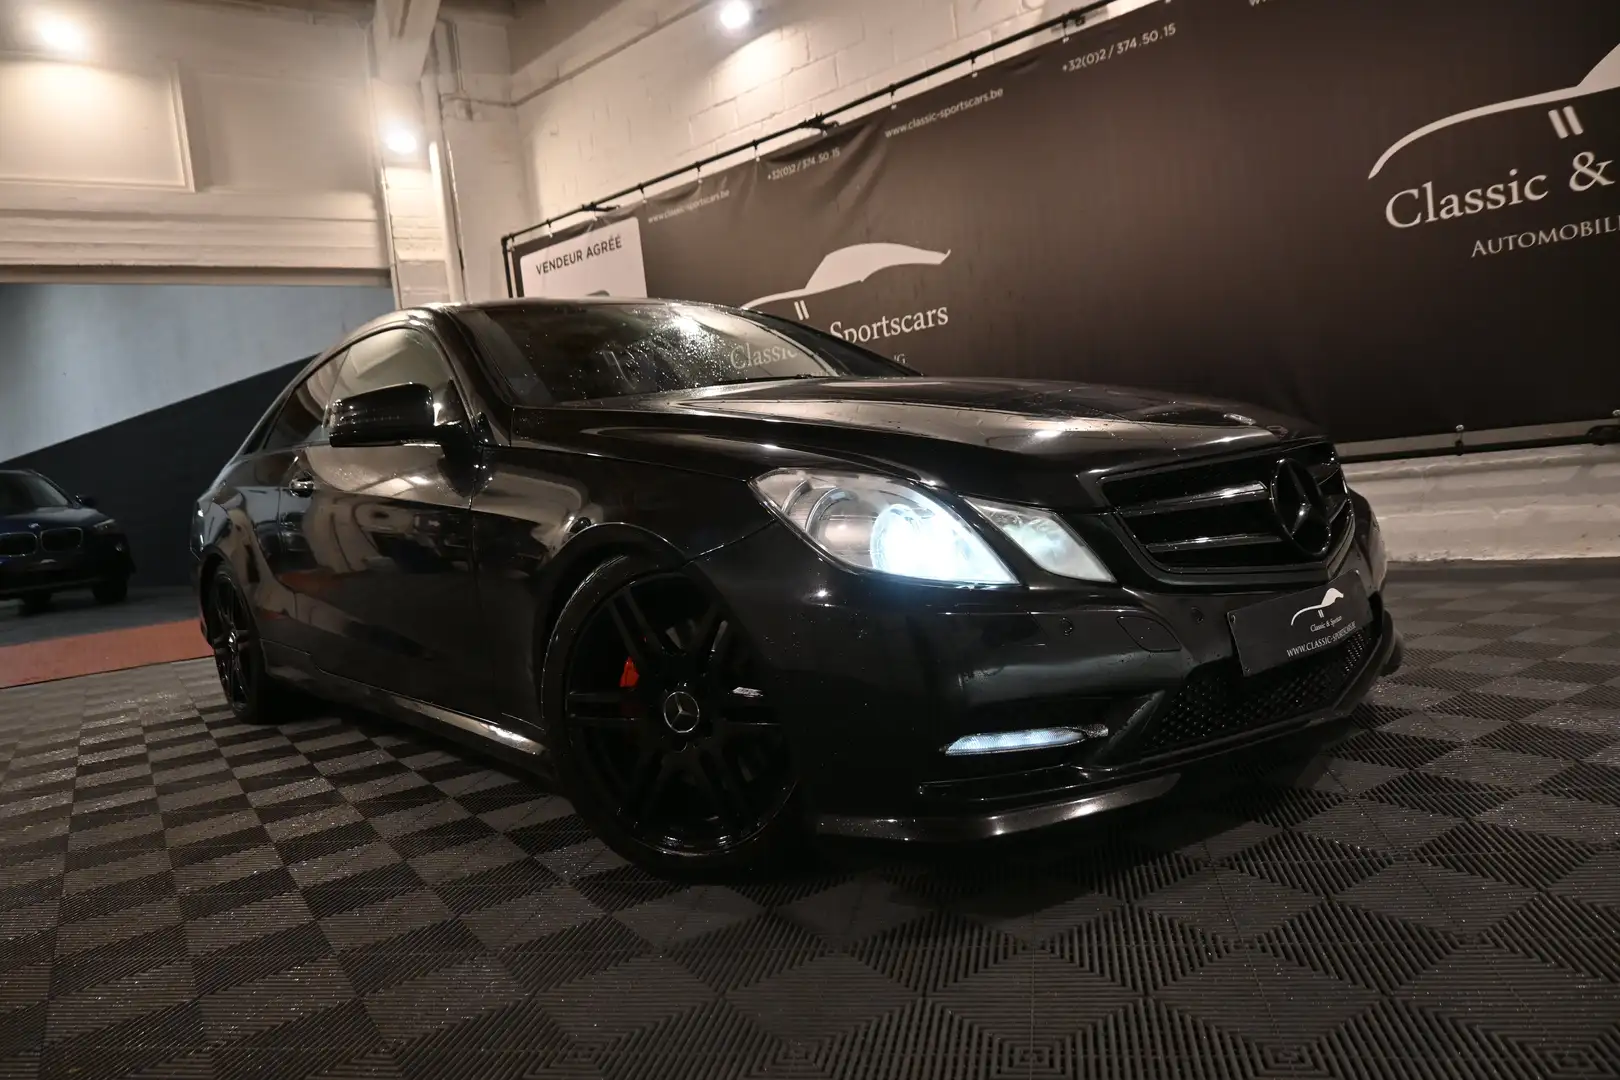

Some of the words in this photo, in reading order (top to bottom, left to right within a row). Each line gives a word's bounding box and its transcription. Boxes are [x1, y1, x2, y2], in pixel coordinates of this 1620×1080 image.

[1062, 48, 1107, 72] +32(0)2
[1116, 23, 1176, 54] 374.50.15
[884, 88, 1003, 138] www.classic-sportscars.be
[1385, 168, 1549, 229] Classic
[1568, 151, 1616, 192] &
[535, 250, 583, 276] VENDEUR
[586, 235, 623, 259] AGRÉÉ
[1470, 215, 1620, 258] AUTOMOBIL
[829, 306, 949, 345] Sportscars
